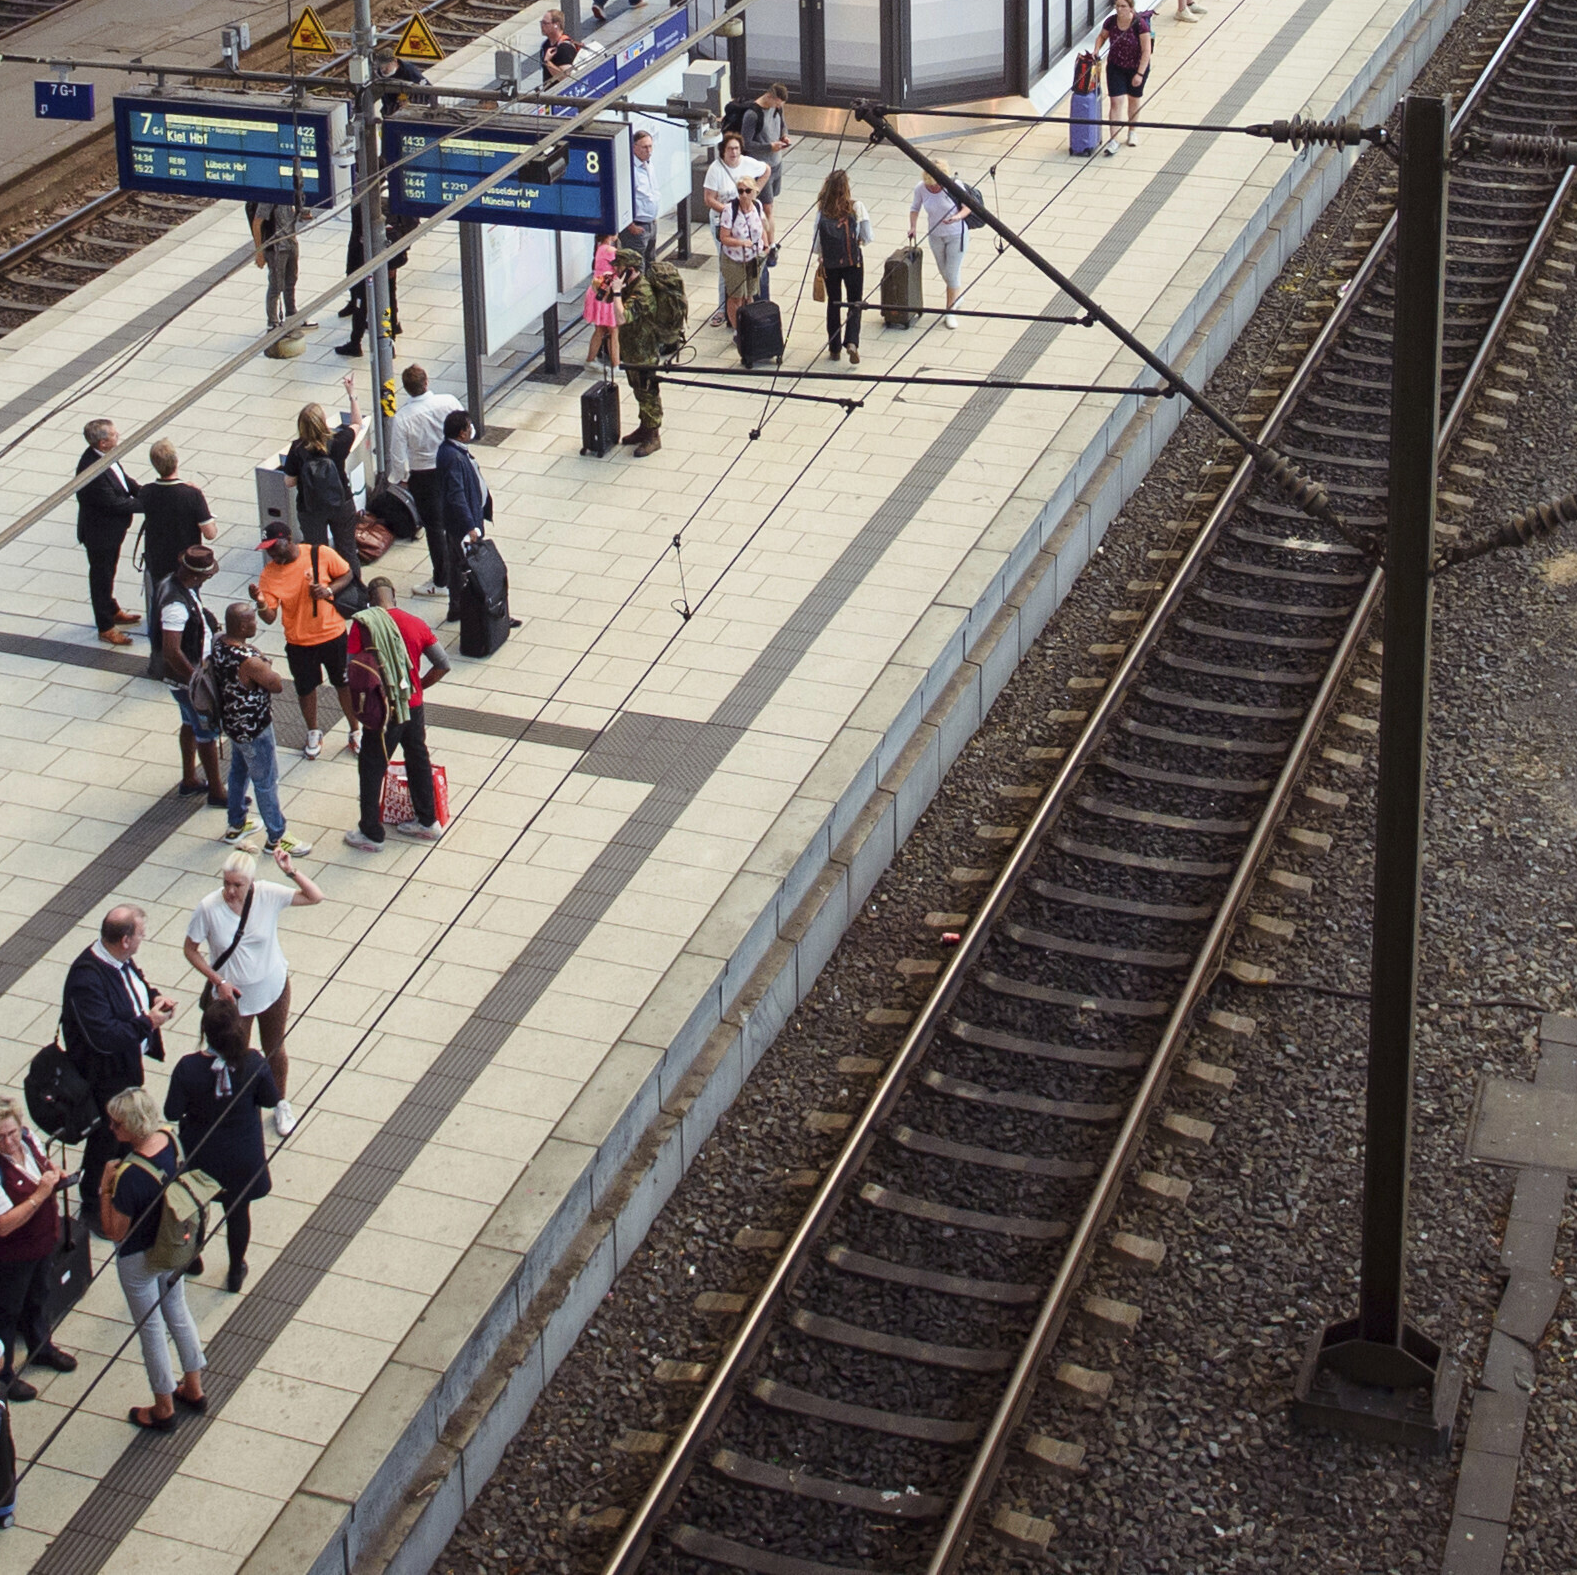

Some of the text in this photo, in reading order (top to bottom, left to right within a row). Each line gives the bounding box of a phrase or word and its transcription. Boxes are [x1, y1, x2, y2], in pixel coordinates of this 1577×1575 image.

[50, 84, 76, 98] 7 G-I
[140, 112, 153, 134] 7
[166, 131, 208, 145] Kiel Hbf
[294, 126, 316, 138] 4:22
[402, 135, 426, 147] 14:33
[133, 153, 153, 163] 14:34
[586, 151, 600, 174] 8
[134, 165, 154, 175] 15:22
[205, 160, 247, 172] Lübeck Hbf
[169, 168, 187, 177] RE70
[206, 171, 235, 181] Kiel Hbf
[404, 178, 425, 188] 14:44
[450, 182, 468, 191] 2213
[405, 189, 426, 199] 15:01
[443, 192, 453, 201] ICE
[483, 185, 539, 198] sseldorf Hbf
[481, 196, 531, 209] München Hbf
